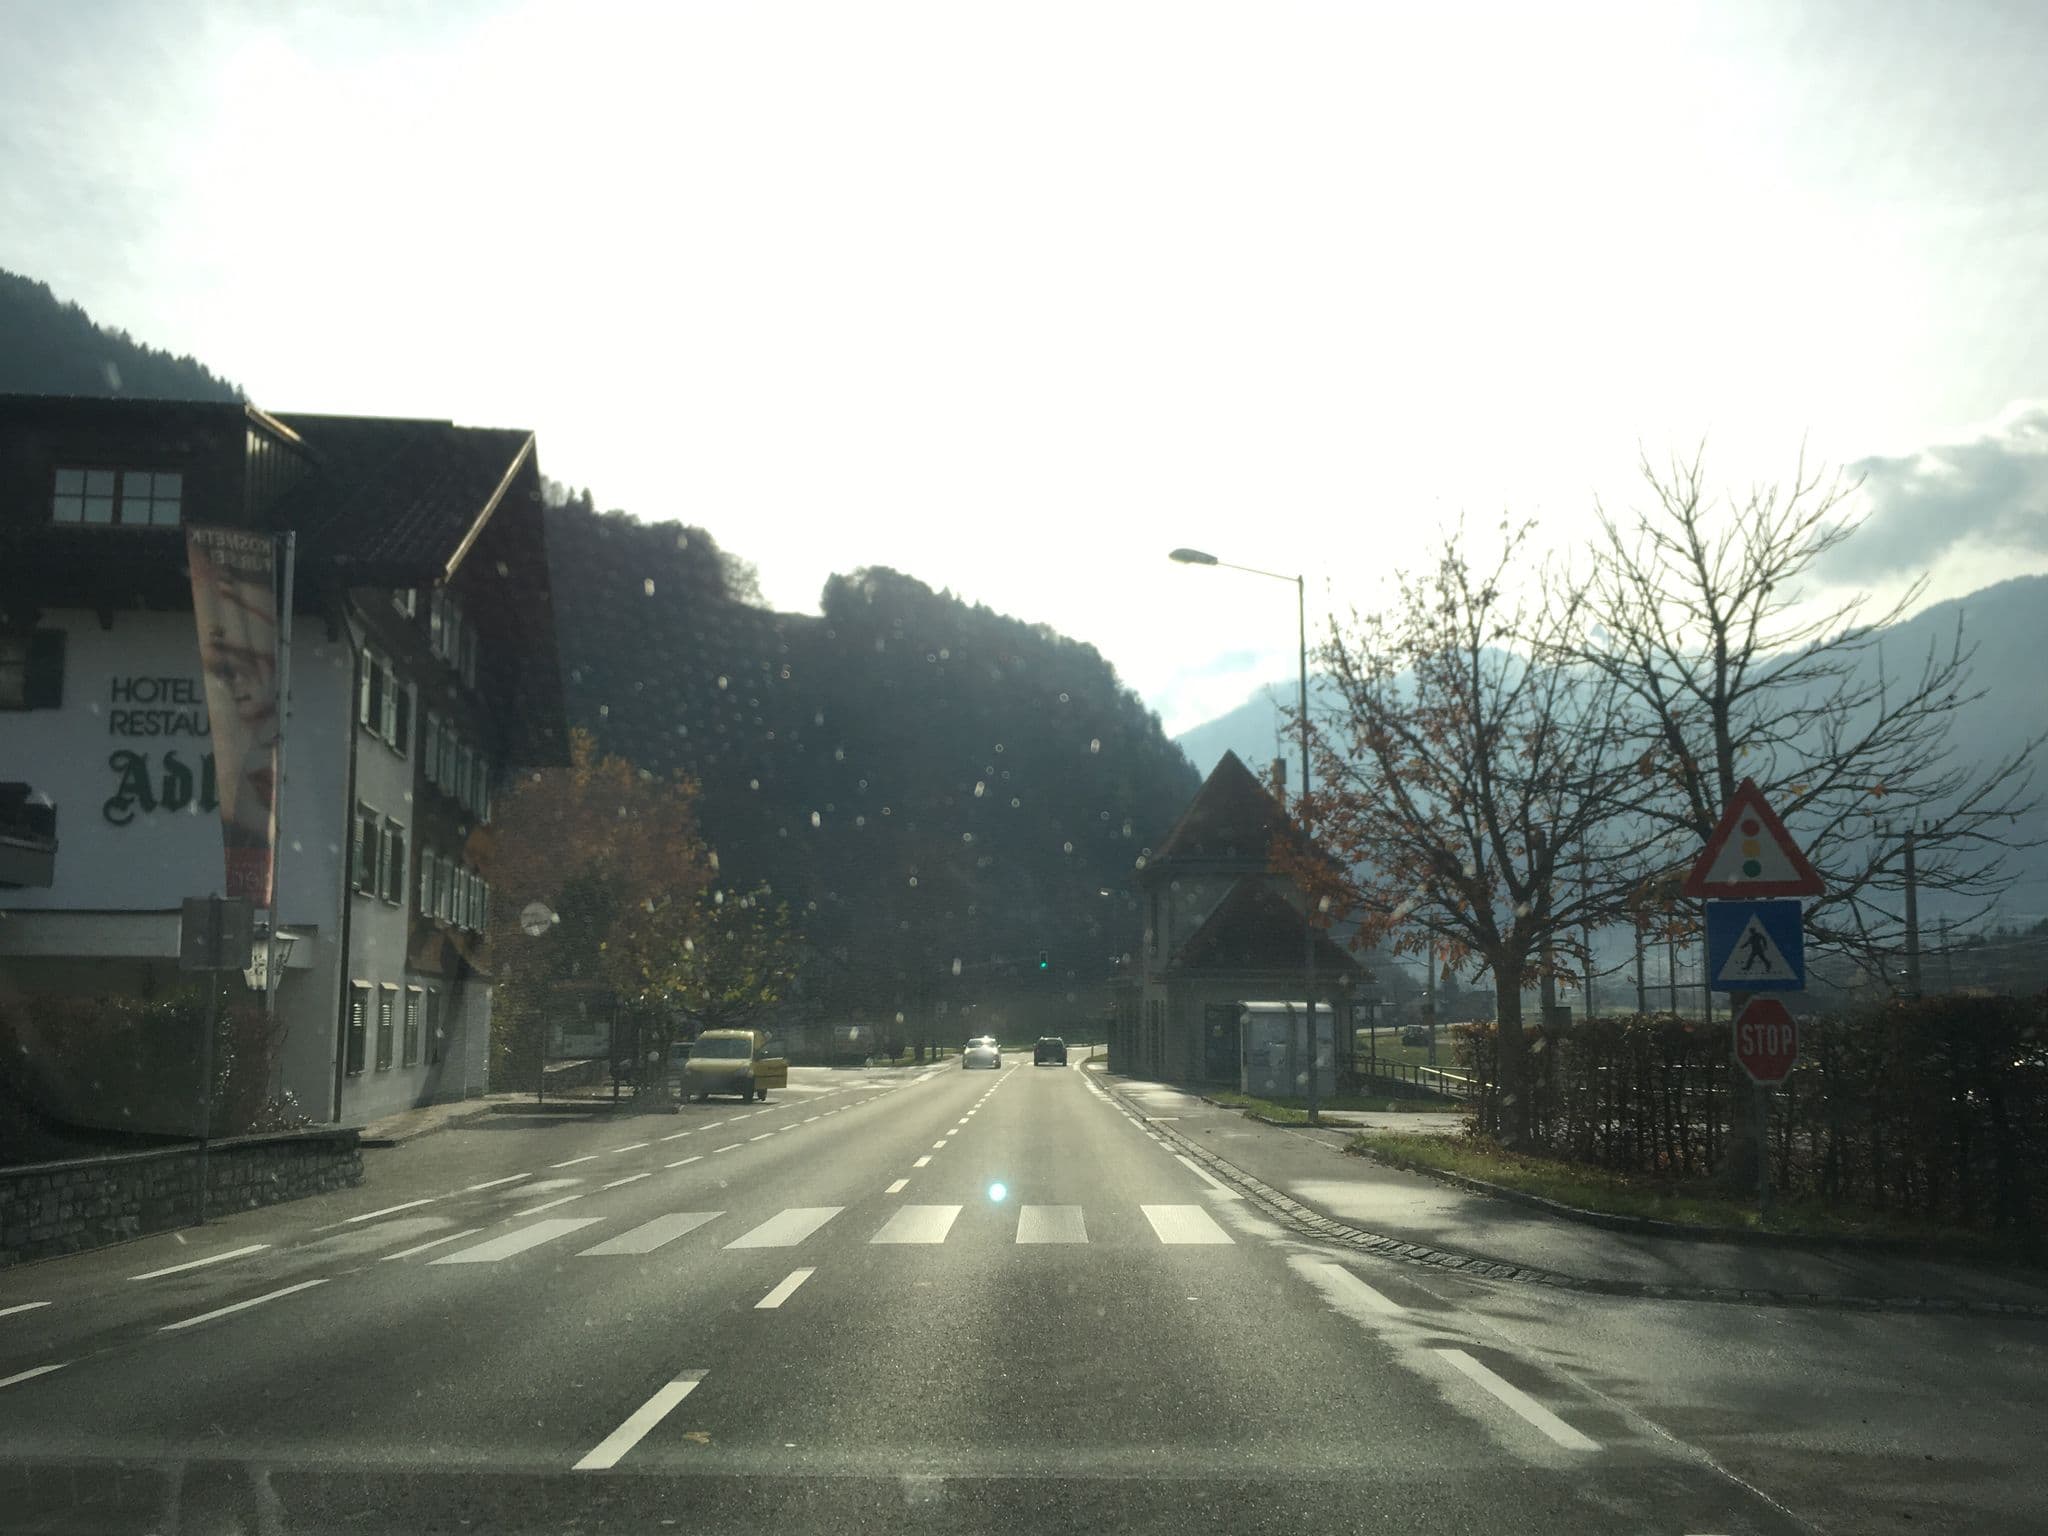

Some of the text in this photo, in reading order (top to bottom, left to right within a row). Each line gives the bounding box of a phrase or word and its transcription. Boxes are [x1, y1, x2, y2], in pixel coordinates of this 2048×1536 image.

[111, 677, 203, 704] HOTEL
[109, 709, 212, 737] RESTAU
[1741, 1023, 1793, 1056] STOP
